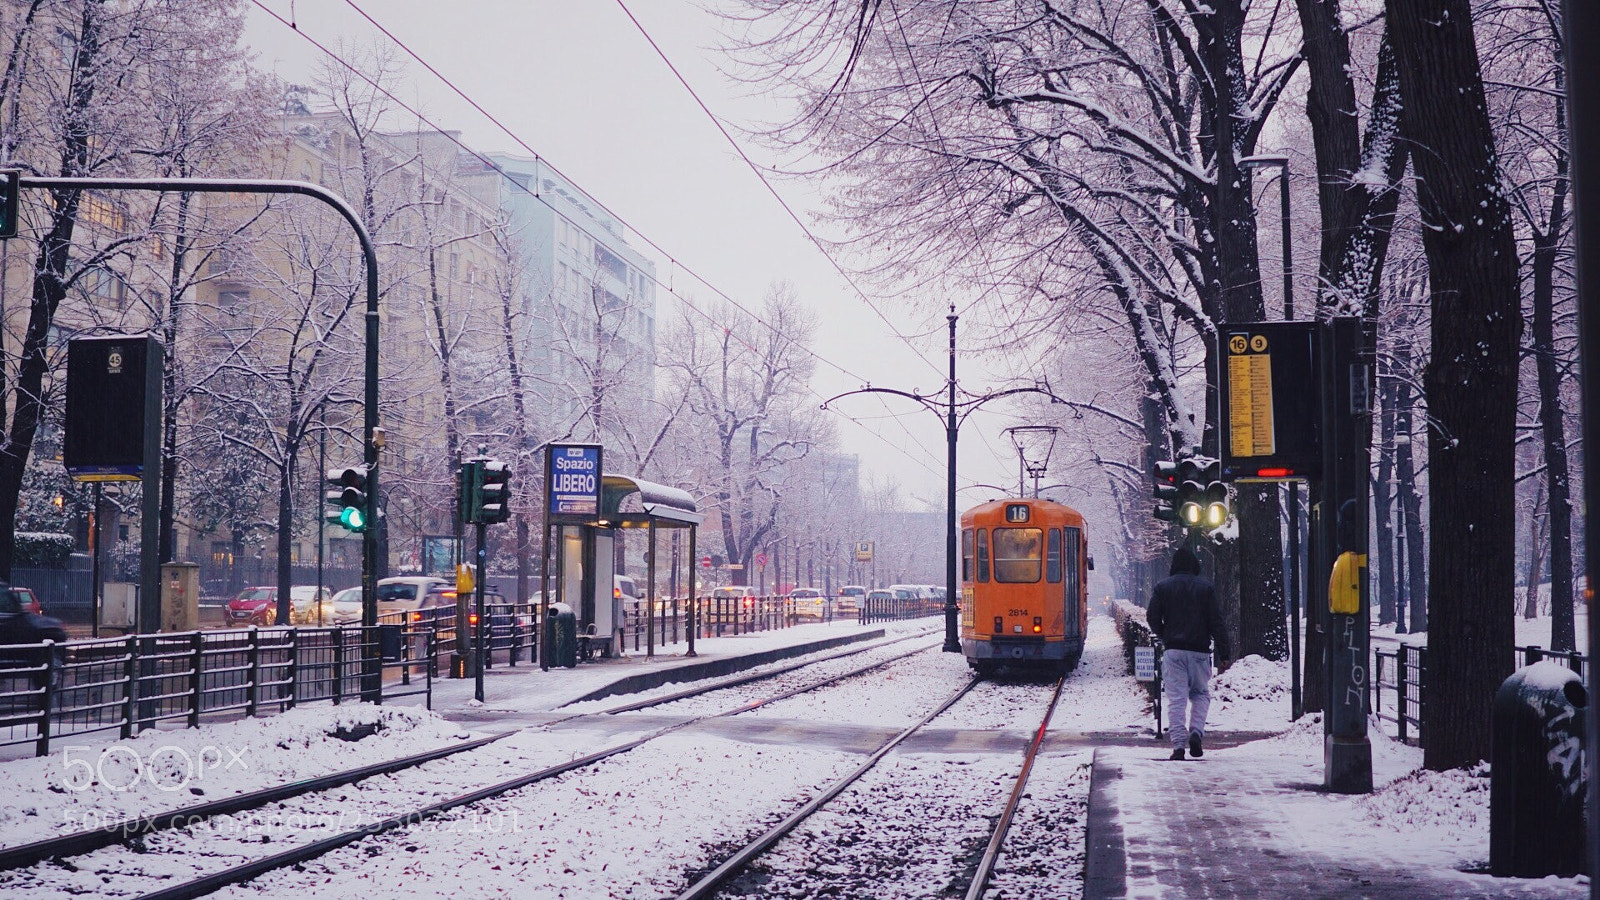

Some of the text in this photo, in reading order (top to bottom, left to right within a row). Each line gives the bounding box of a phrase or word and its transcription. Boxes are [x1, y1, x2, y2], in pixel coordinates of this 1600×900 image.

[1231, 339, 1245, 350] 16
[1255, 339, 1262, 349] 9
[110, 355, 120, 364] 45
[556, 457, 594, 471] Spazio
[553, 474, 595, 492] LIBERO
[1012, 506, 1027, 520] 16
[1008, 609, 1028, 617] 2814
